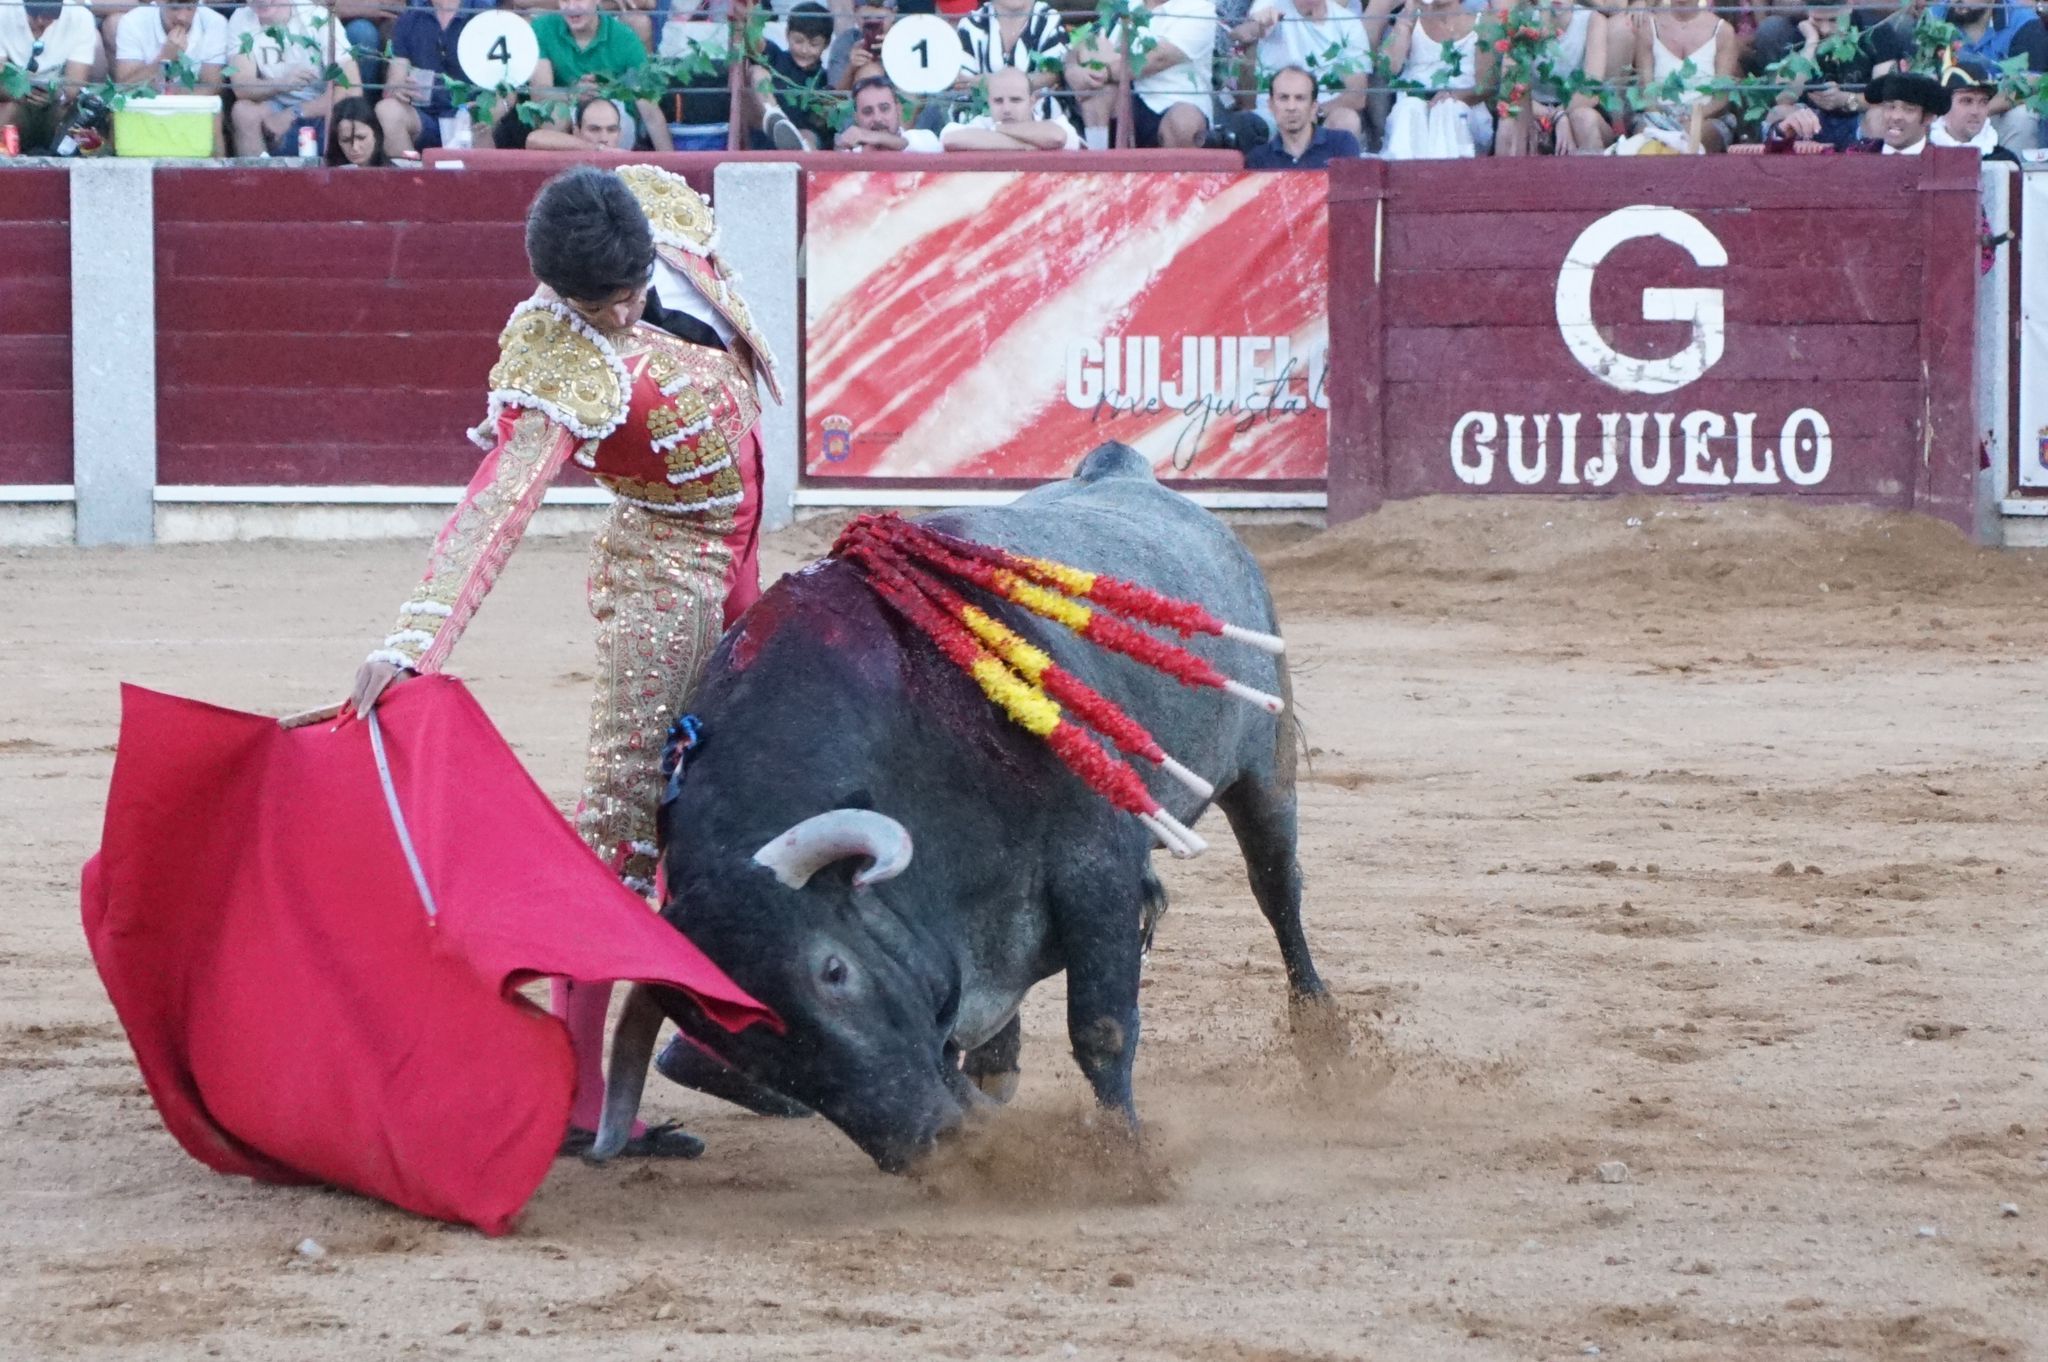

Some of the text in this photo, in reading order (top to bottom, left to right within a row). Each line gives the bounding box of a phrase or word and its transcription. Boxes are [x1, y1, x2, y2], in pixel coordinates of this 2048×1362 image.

[487, 34, 511, 65] 4
[911, 38, 928, 68] 1
[1556, 204, 1728, 394] G
[1450, 407, 1832, 486] GUIJUELO
